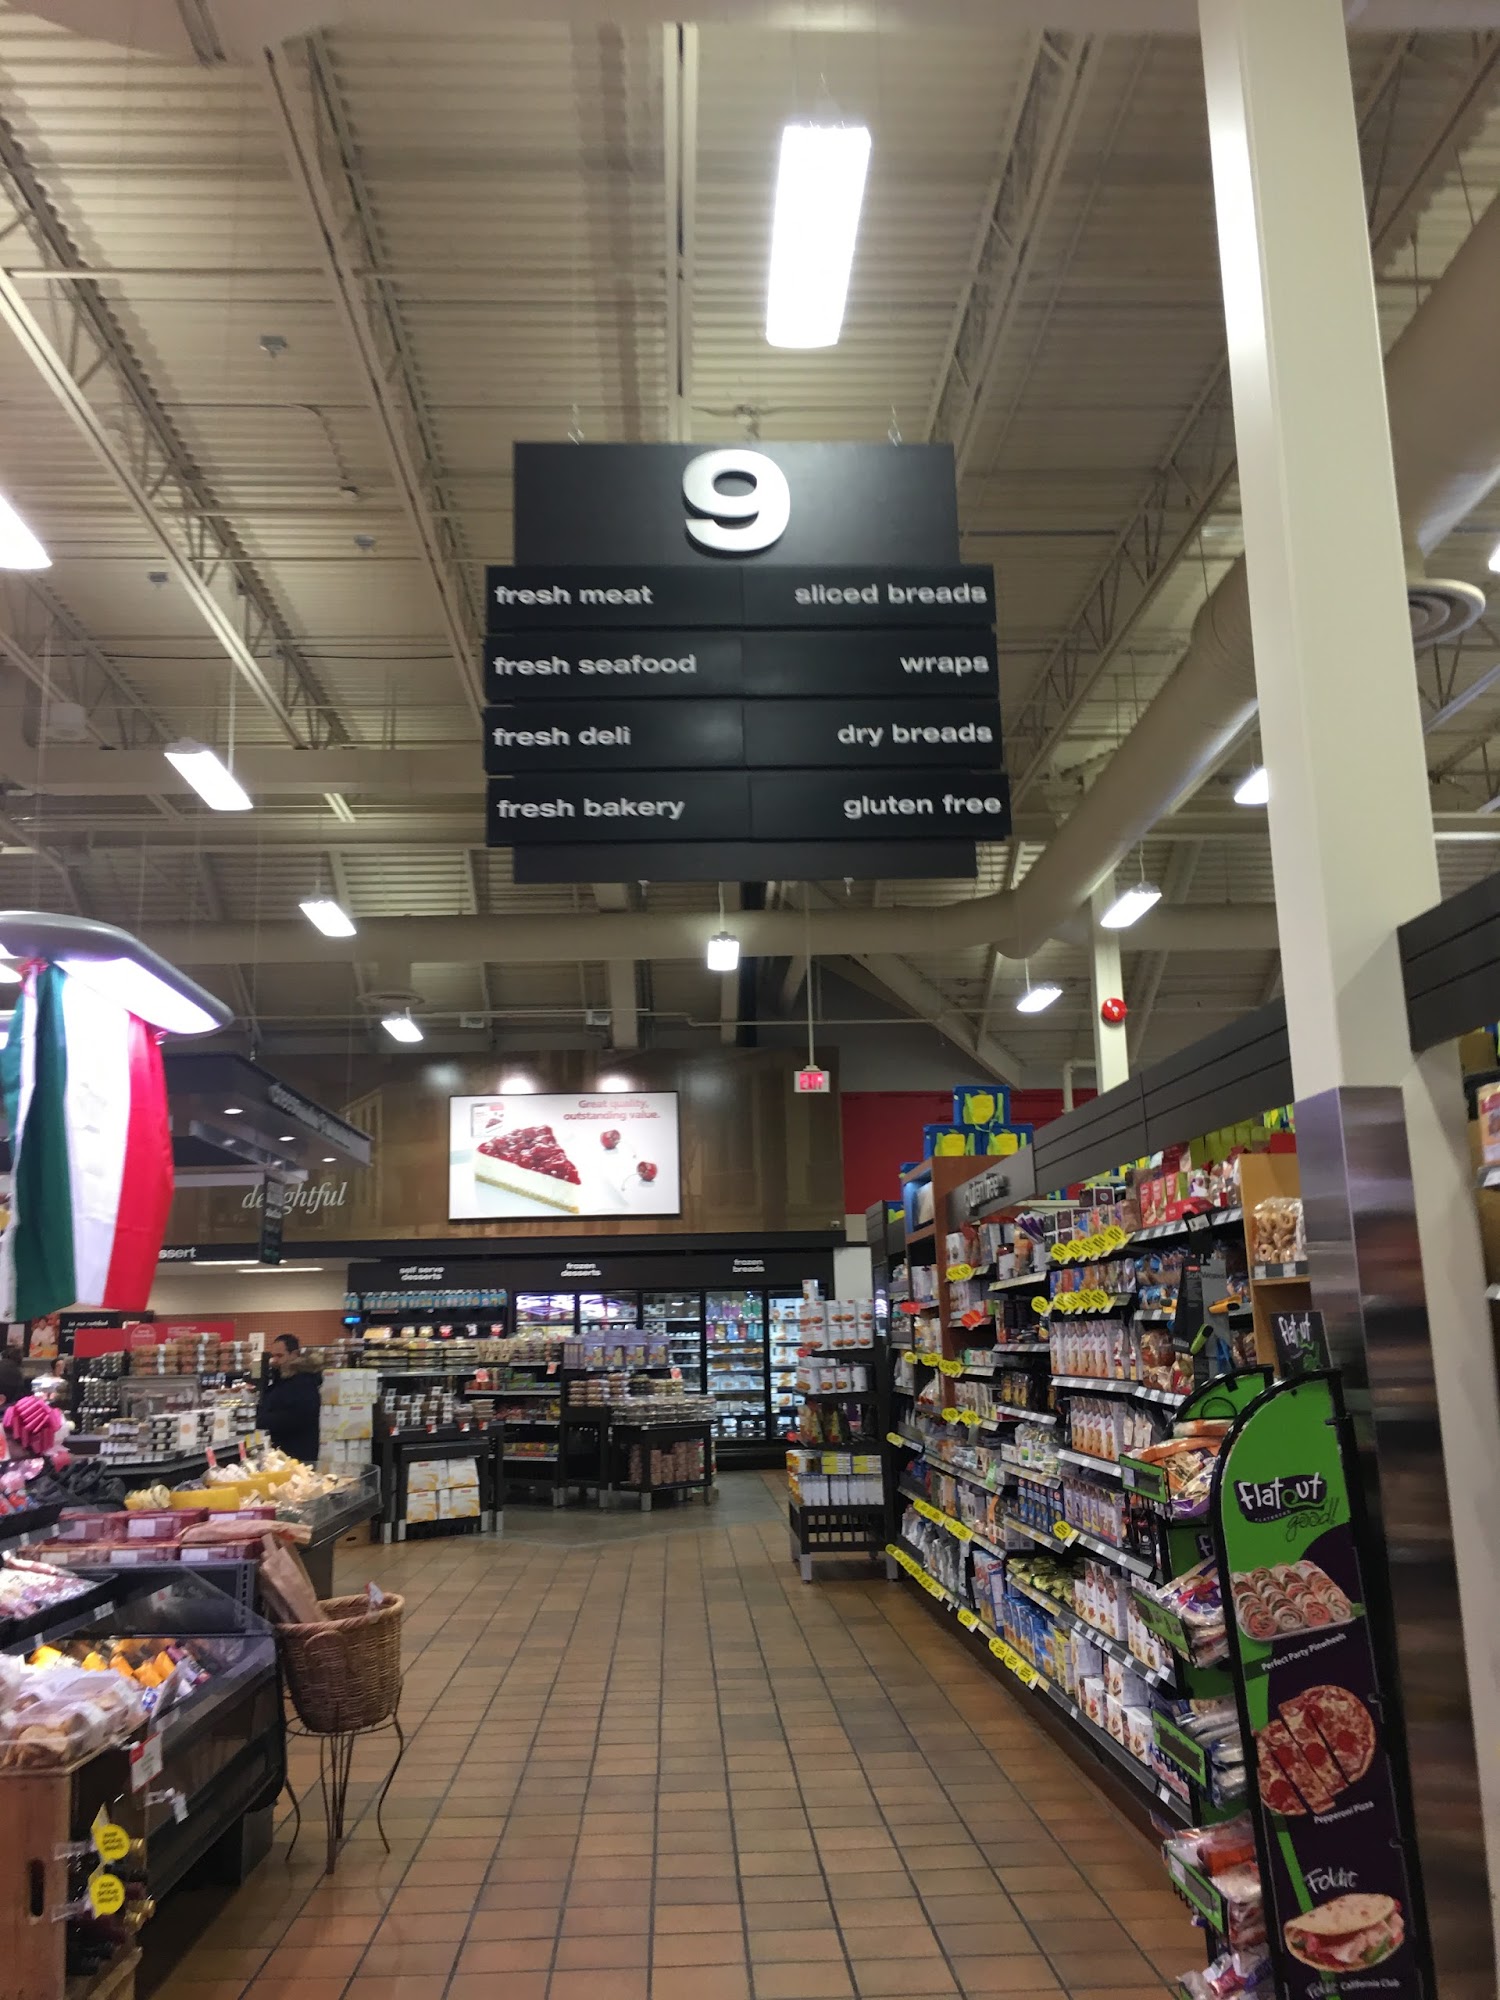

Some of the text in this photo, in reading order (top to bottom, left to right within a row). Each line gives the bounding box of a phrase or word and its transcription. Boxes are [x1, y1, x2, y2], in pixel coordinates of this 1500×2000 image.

[682, 449, 791, 552] 9
[494, 586, 653, 605] fresh meat
[795, 583, 988, 605] sliced breads
[492, 655, 697, 676] fresh seafood
[900, 655, 990, 676] wraps
[492, 726, 632, 746] fresh deli
[837, 723, 993, 747] dry breads
[496, 798, 685, 821] fresh bakery
[844, 794, 1002, 819] gluten free
[578, 1100, 608, 1109] Great
[563, 1111, 627, 1122] outstanding
[241, 1181, 348, 1215] deghtful
[158, 1246, 197, 1259] ssert
[401, 1273, 443, 1281] desserts
[560, 1269, 602, 1277] desserts
[1261, 1632, 1347, 1671] Perfect Party Pinwheels
[1313, 1801, 1375, 1824] Pepperoni Pizza
